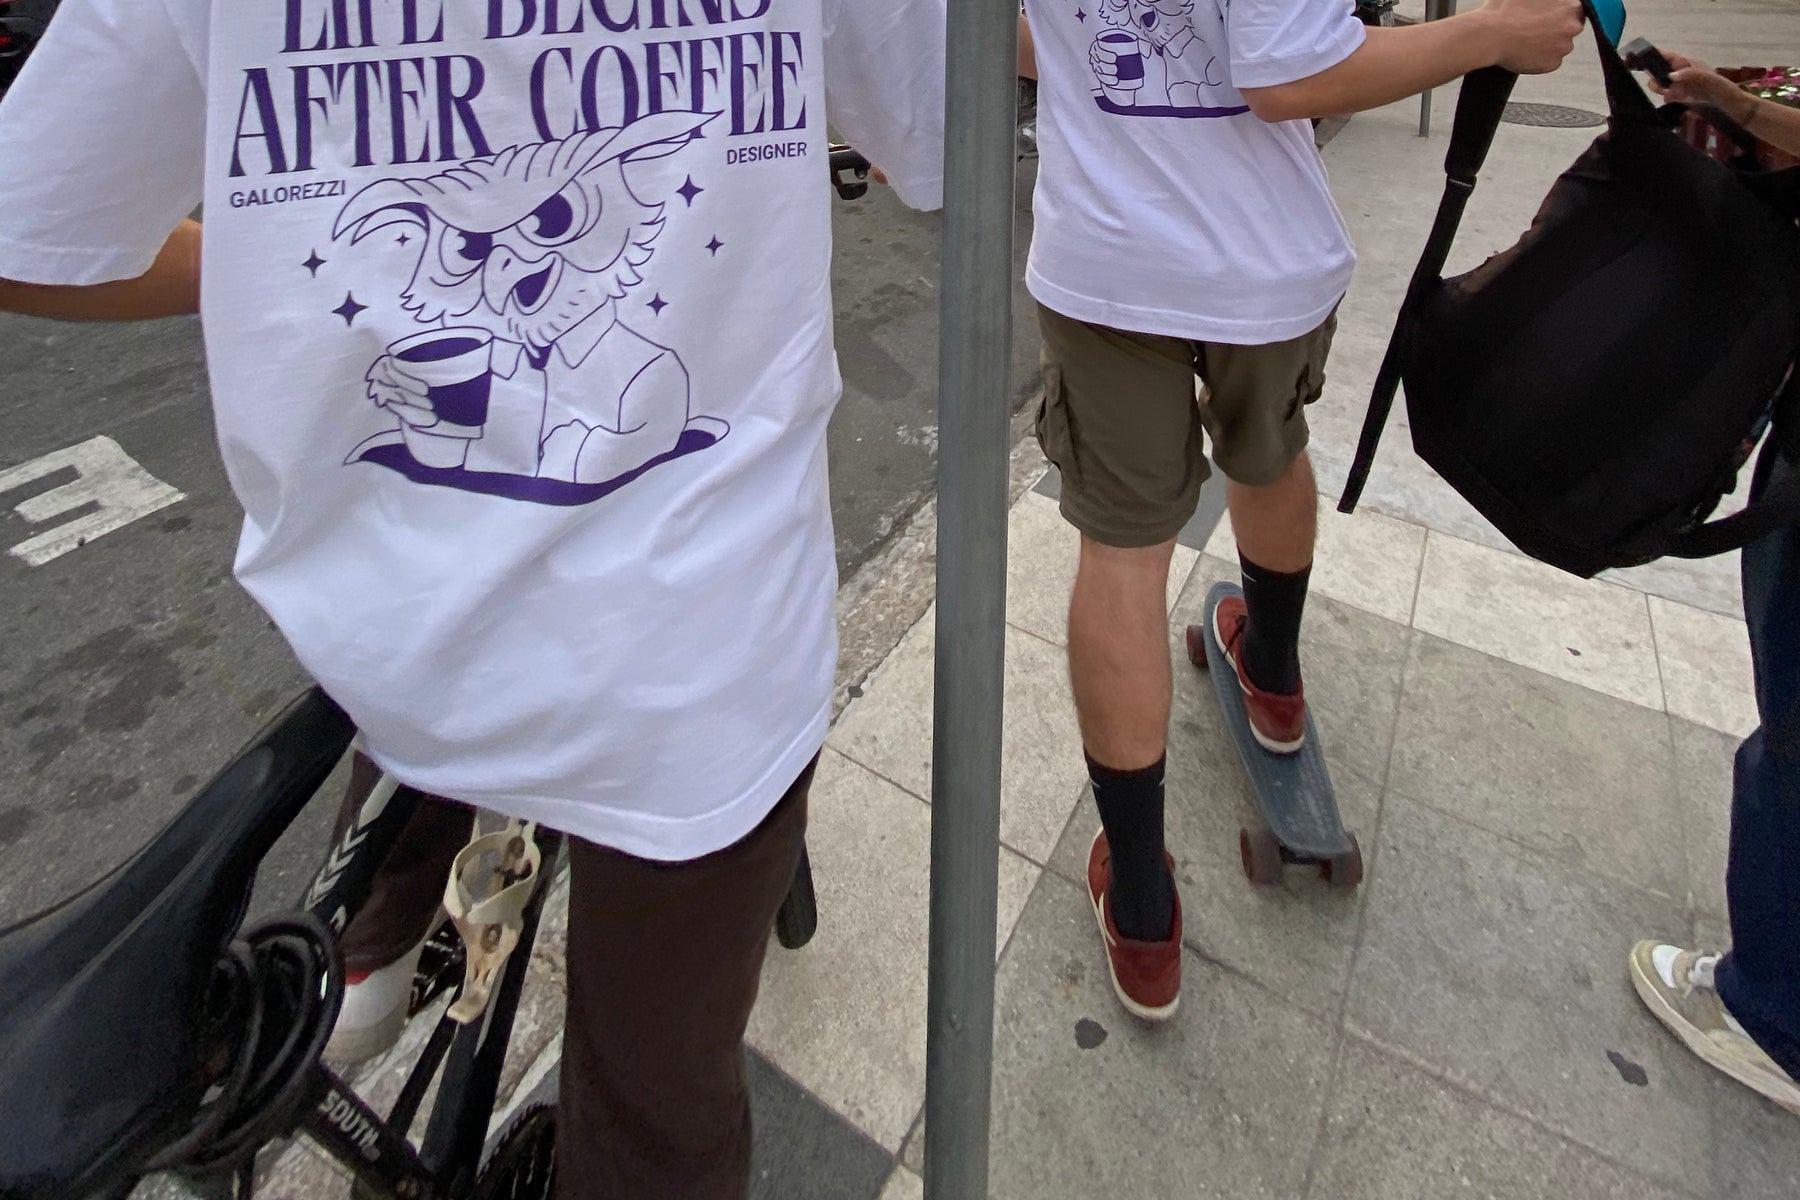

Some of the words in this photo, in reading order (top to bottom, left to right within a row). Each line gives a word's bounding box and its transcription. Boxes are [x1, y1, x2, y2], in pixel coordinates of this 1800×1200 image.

[229, 55, 498, 178] AFTER
[530, 31, 807, 142] COFFEE
[229, 182, 347, 209] GALOREZZI
[727, 143, 807, 165] DESIGNER
